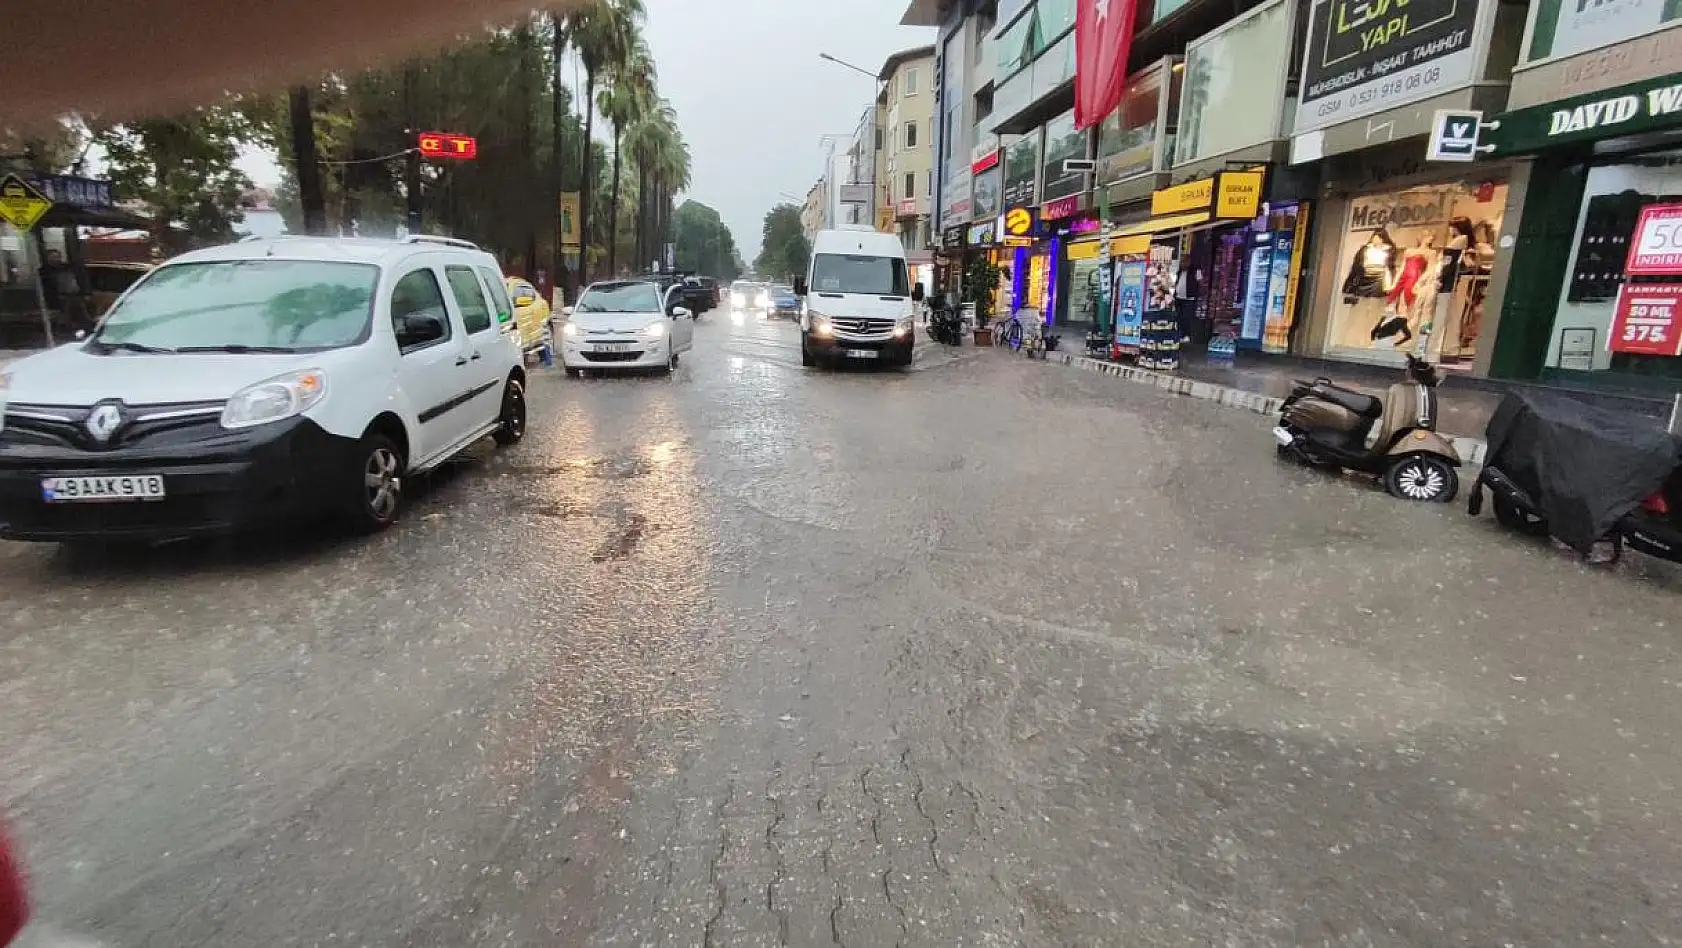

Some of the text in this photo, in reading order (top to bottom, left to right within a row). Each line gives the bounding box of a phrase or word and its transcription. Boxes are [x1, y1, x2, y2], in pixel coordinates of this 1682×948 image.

[1360, 14, 1408, 51] YAPI
[1318, 99, 1342, 117] GSM
[1547, 95, 1640, 136] DAVID
